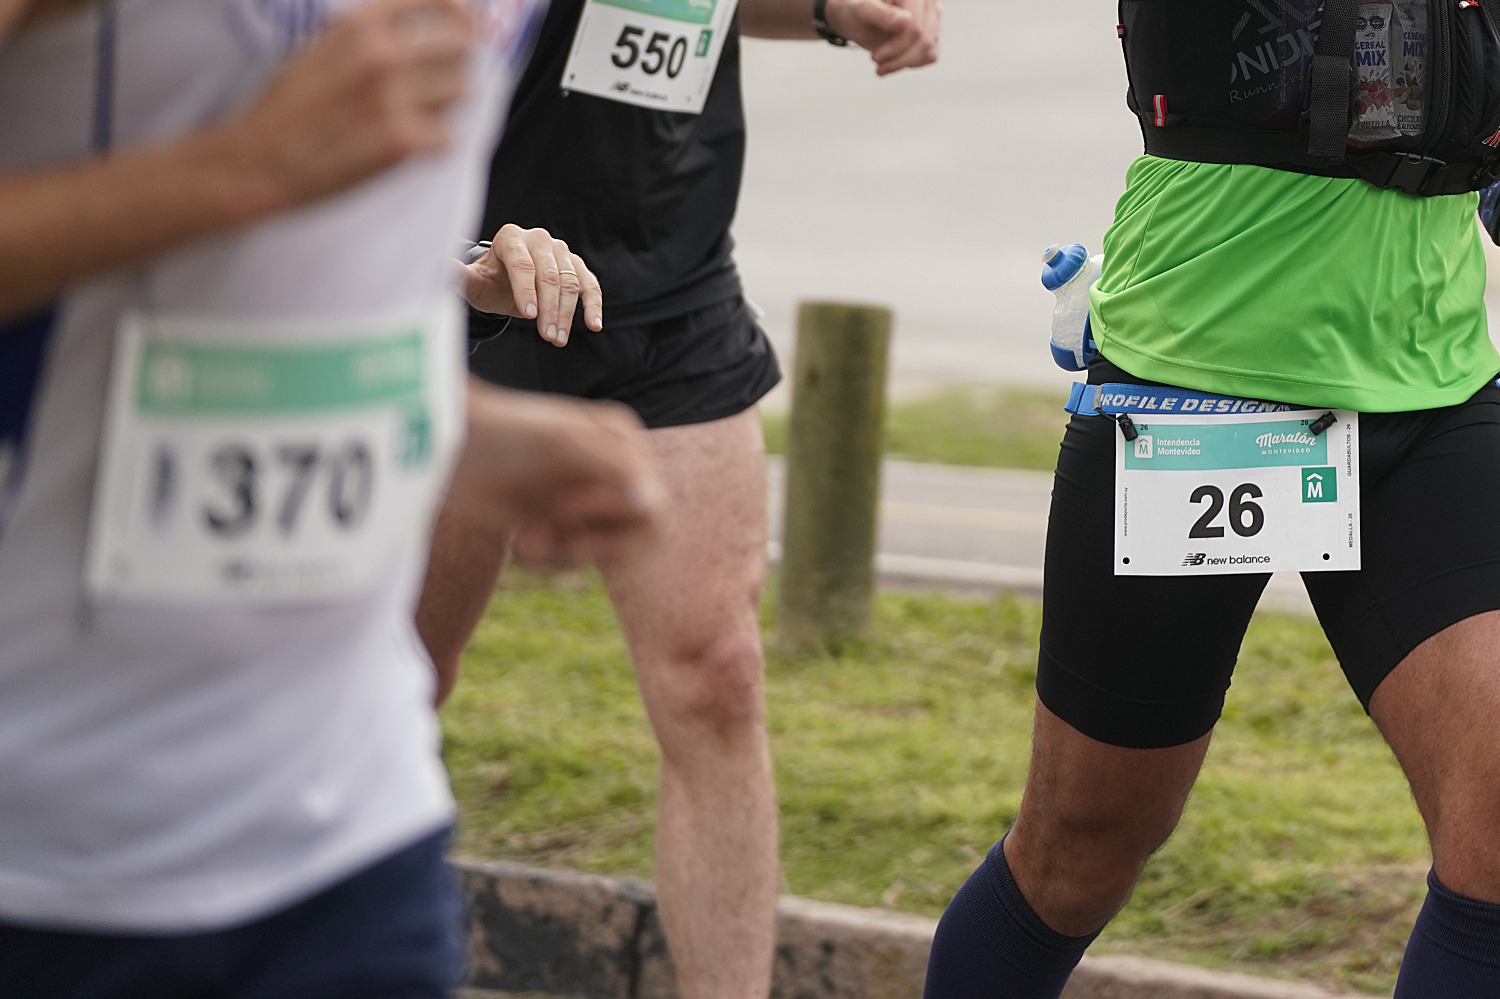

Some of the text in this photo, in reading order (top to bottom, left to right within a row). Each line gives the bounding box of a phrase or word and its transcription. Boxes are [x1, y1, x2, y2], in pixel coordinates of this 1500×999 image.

[611, 23, 688, 79] 550
[1355, 40, 1386, 50] CEREAL
[1355, 50, 1386, 67] MIX
[1181, 399, 1277, 413] DESIGN
[1157, 438, 1200, 446] Intendencia
[1255, 431, 1317, 447] Maratón
[1157, 447, 1201, 456] Montevideo
[1188, 483, 1265, 539] 26
[1207, 557, 1227, 565] new
[1229, 555, 1271, 565] balance
